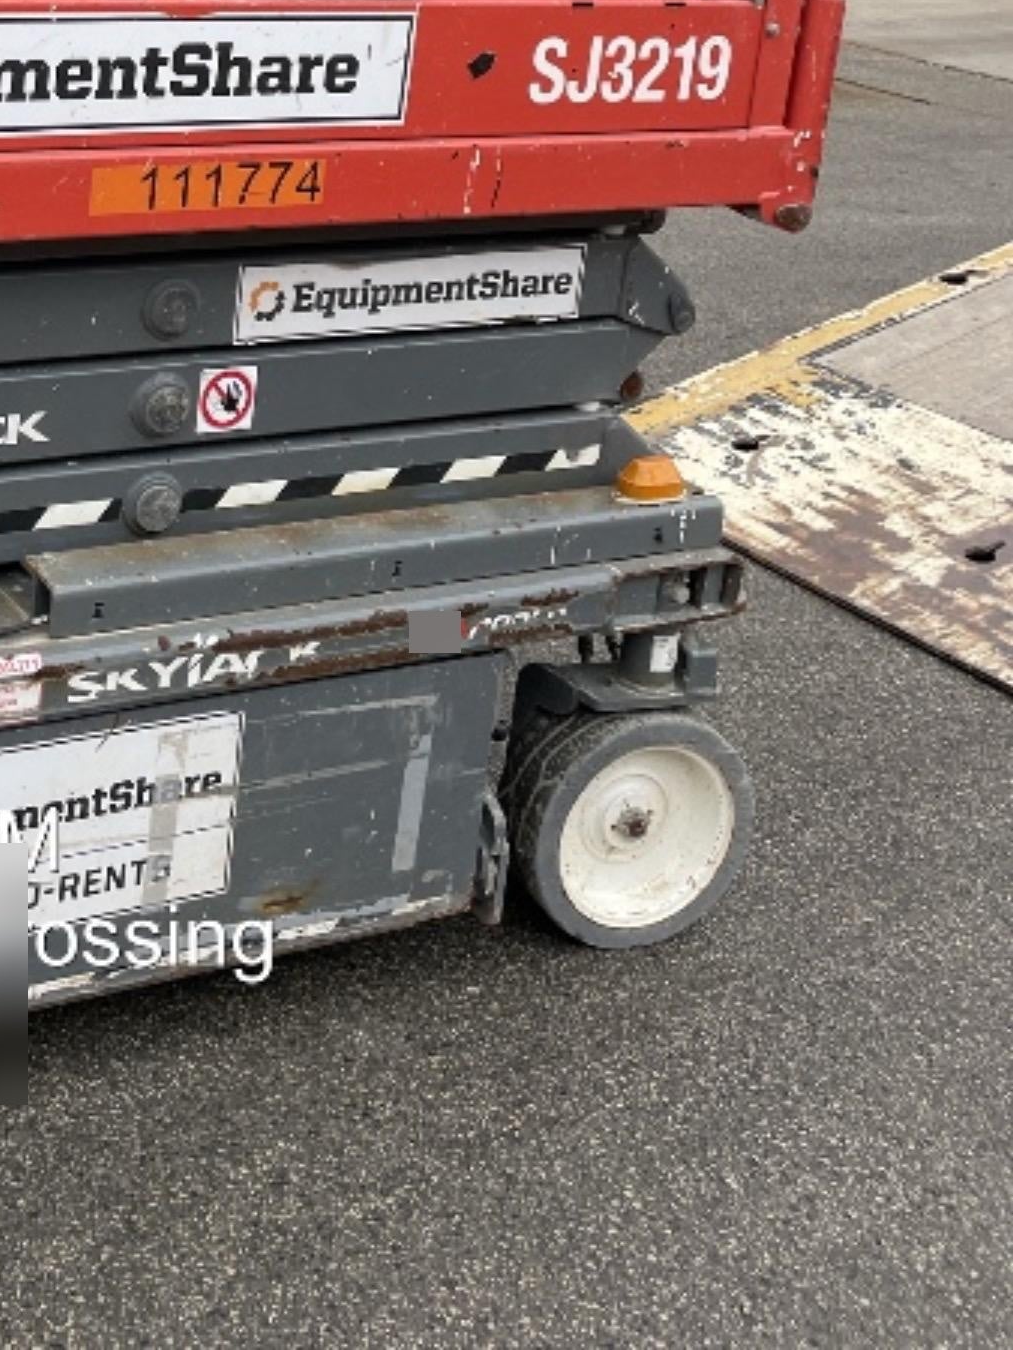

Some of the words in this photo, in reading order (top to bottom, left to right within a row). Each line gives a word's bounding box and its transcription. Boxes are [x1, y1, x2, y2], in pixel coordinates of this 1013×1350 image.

[528, 35, 732, 103] SJ3219
[140, 160, 321, 210] 111774
[291, 269, 573, 317] EquipmentShare
[68, 633, 321, 713] SKYJAK
